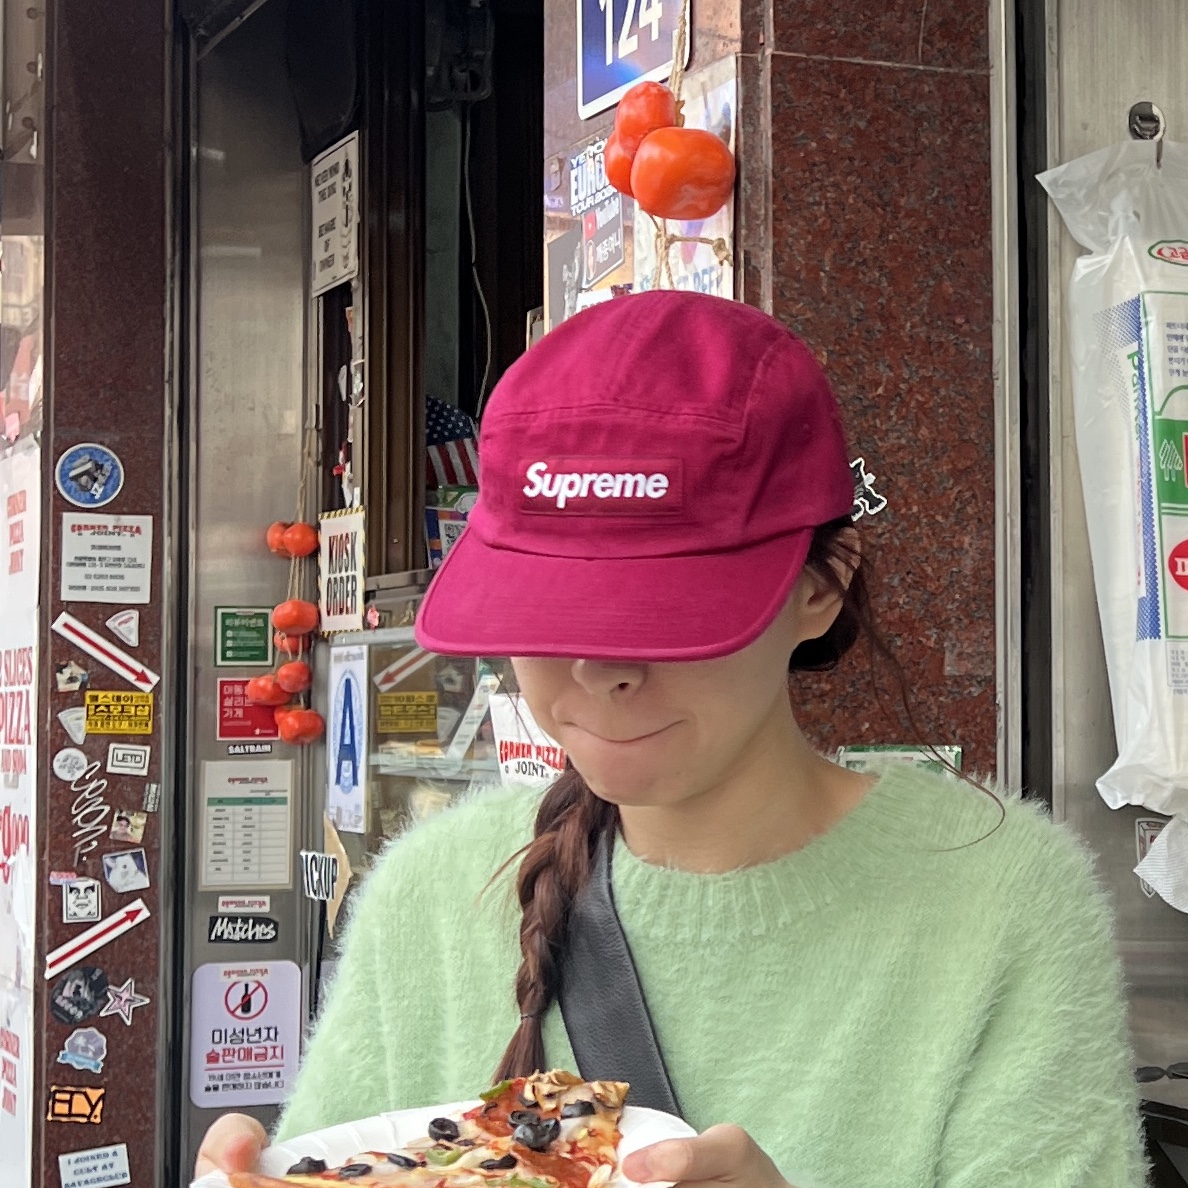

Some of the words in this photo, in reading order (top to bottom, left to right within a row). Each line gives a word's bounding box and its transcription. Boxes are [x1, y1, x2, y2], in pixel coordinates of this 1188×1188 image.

[523, 461, 669, 509] Supreme
[328, 532, 357, 574] KIOSK
[326, 575, 357, 616] ORDER
[0, 689, 31, 745] IZZA
[336, 678, 358, 786] A
[515, 761, 546, 777] JOINT
[206, 1045, 284, 1064] 술판매금지
[211, 1026, 279, 1045] 미성년자
